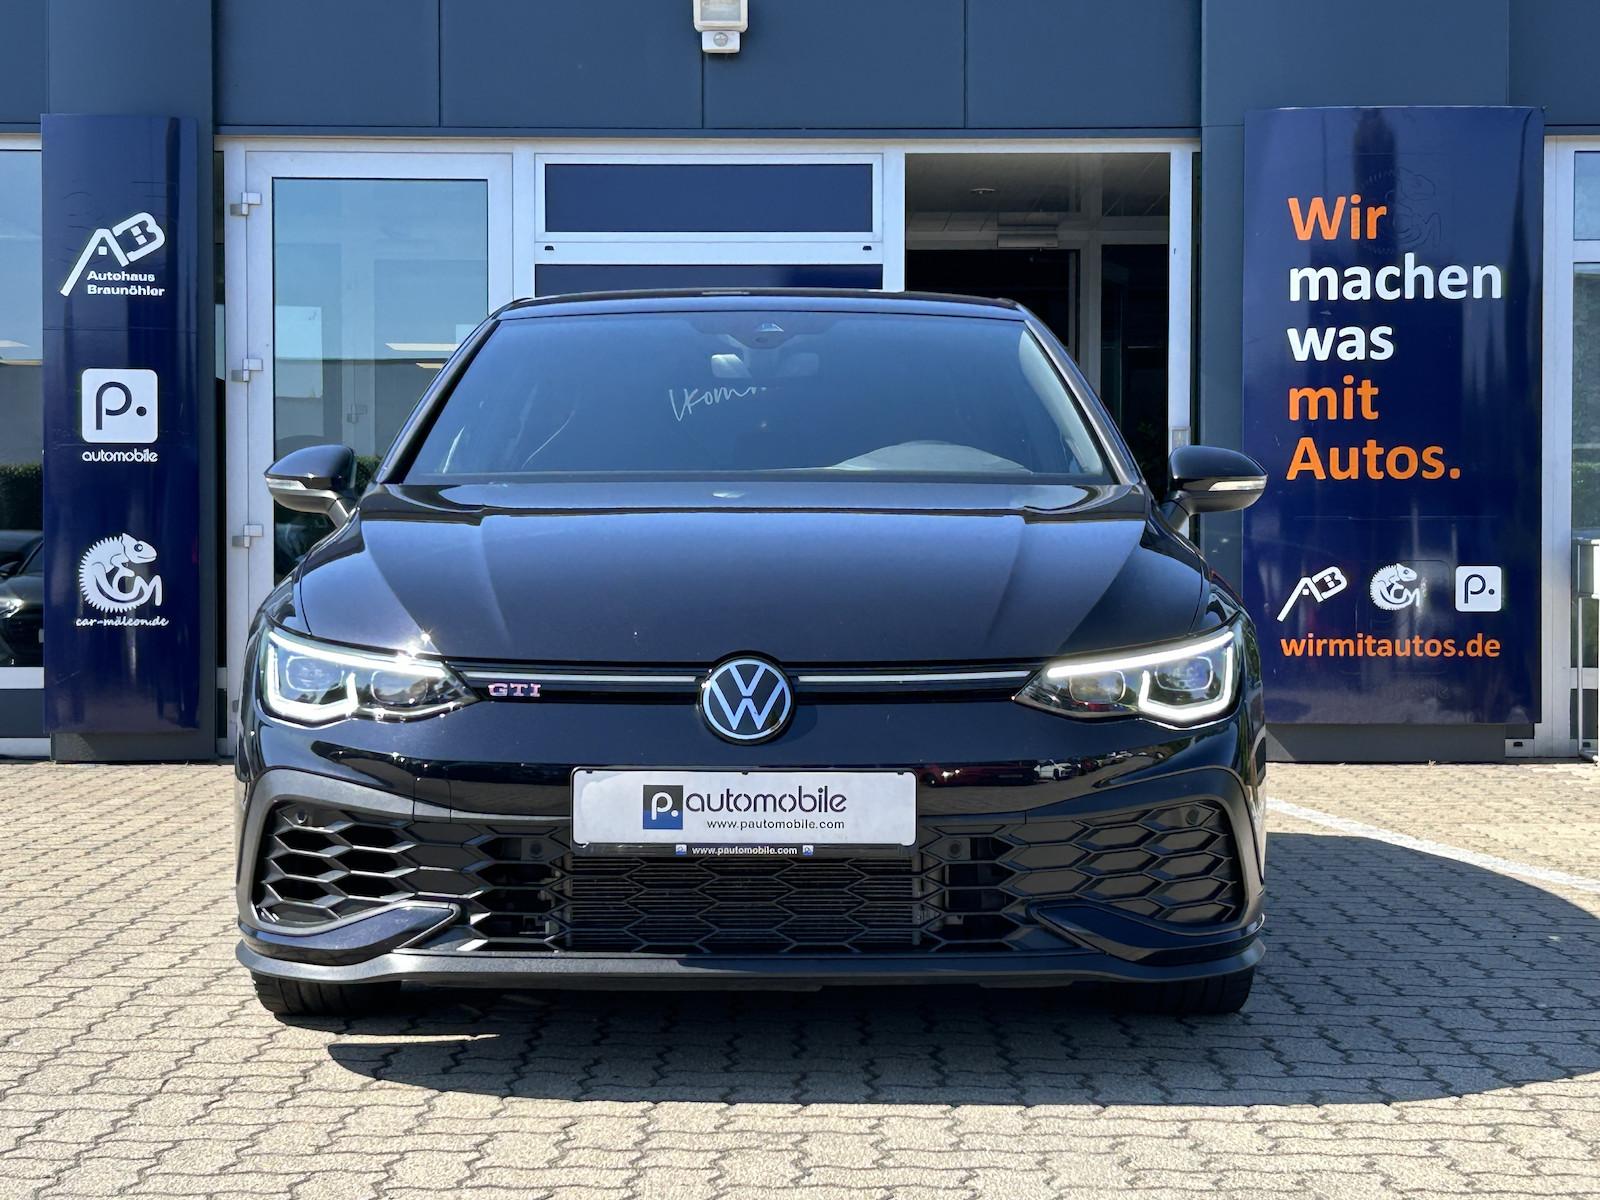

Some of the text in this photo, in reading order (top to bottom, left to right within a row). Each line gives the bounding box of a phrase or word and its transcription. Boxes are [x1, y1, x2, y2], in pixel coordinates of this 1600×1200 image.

[1287, 194, 1388, 240] Wir
[87, 270, 156, 282] Autohaus
[1289, 252, 1502, 301] machen
[87, 284, 165, 296] Braunöhler
[1287, 324, 1395, 361] was
[1289, 374, 1379, 421] mit
[82, 448, 158, 463] automobile
[1286, 436, 1462, 481] Autos.
[1280, 632, 1501, 657] wirmitautos.de
[488, 682, 541, 697] GTI
[686, 785, 847, 813] automobile
[706, 818, 845, 831] www.pautomobile.com
[692, 845, 798, 856] www.pautomobile.com
